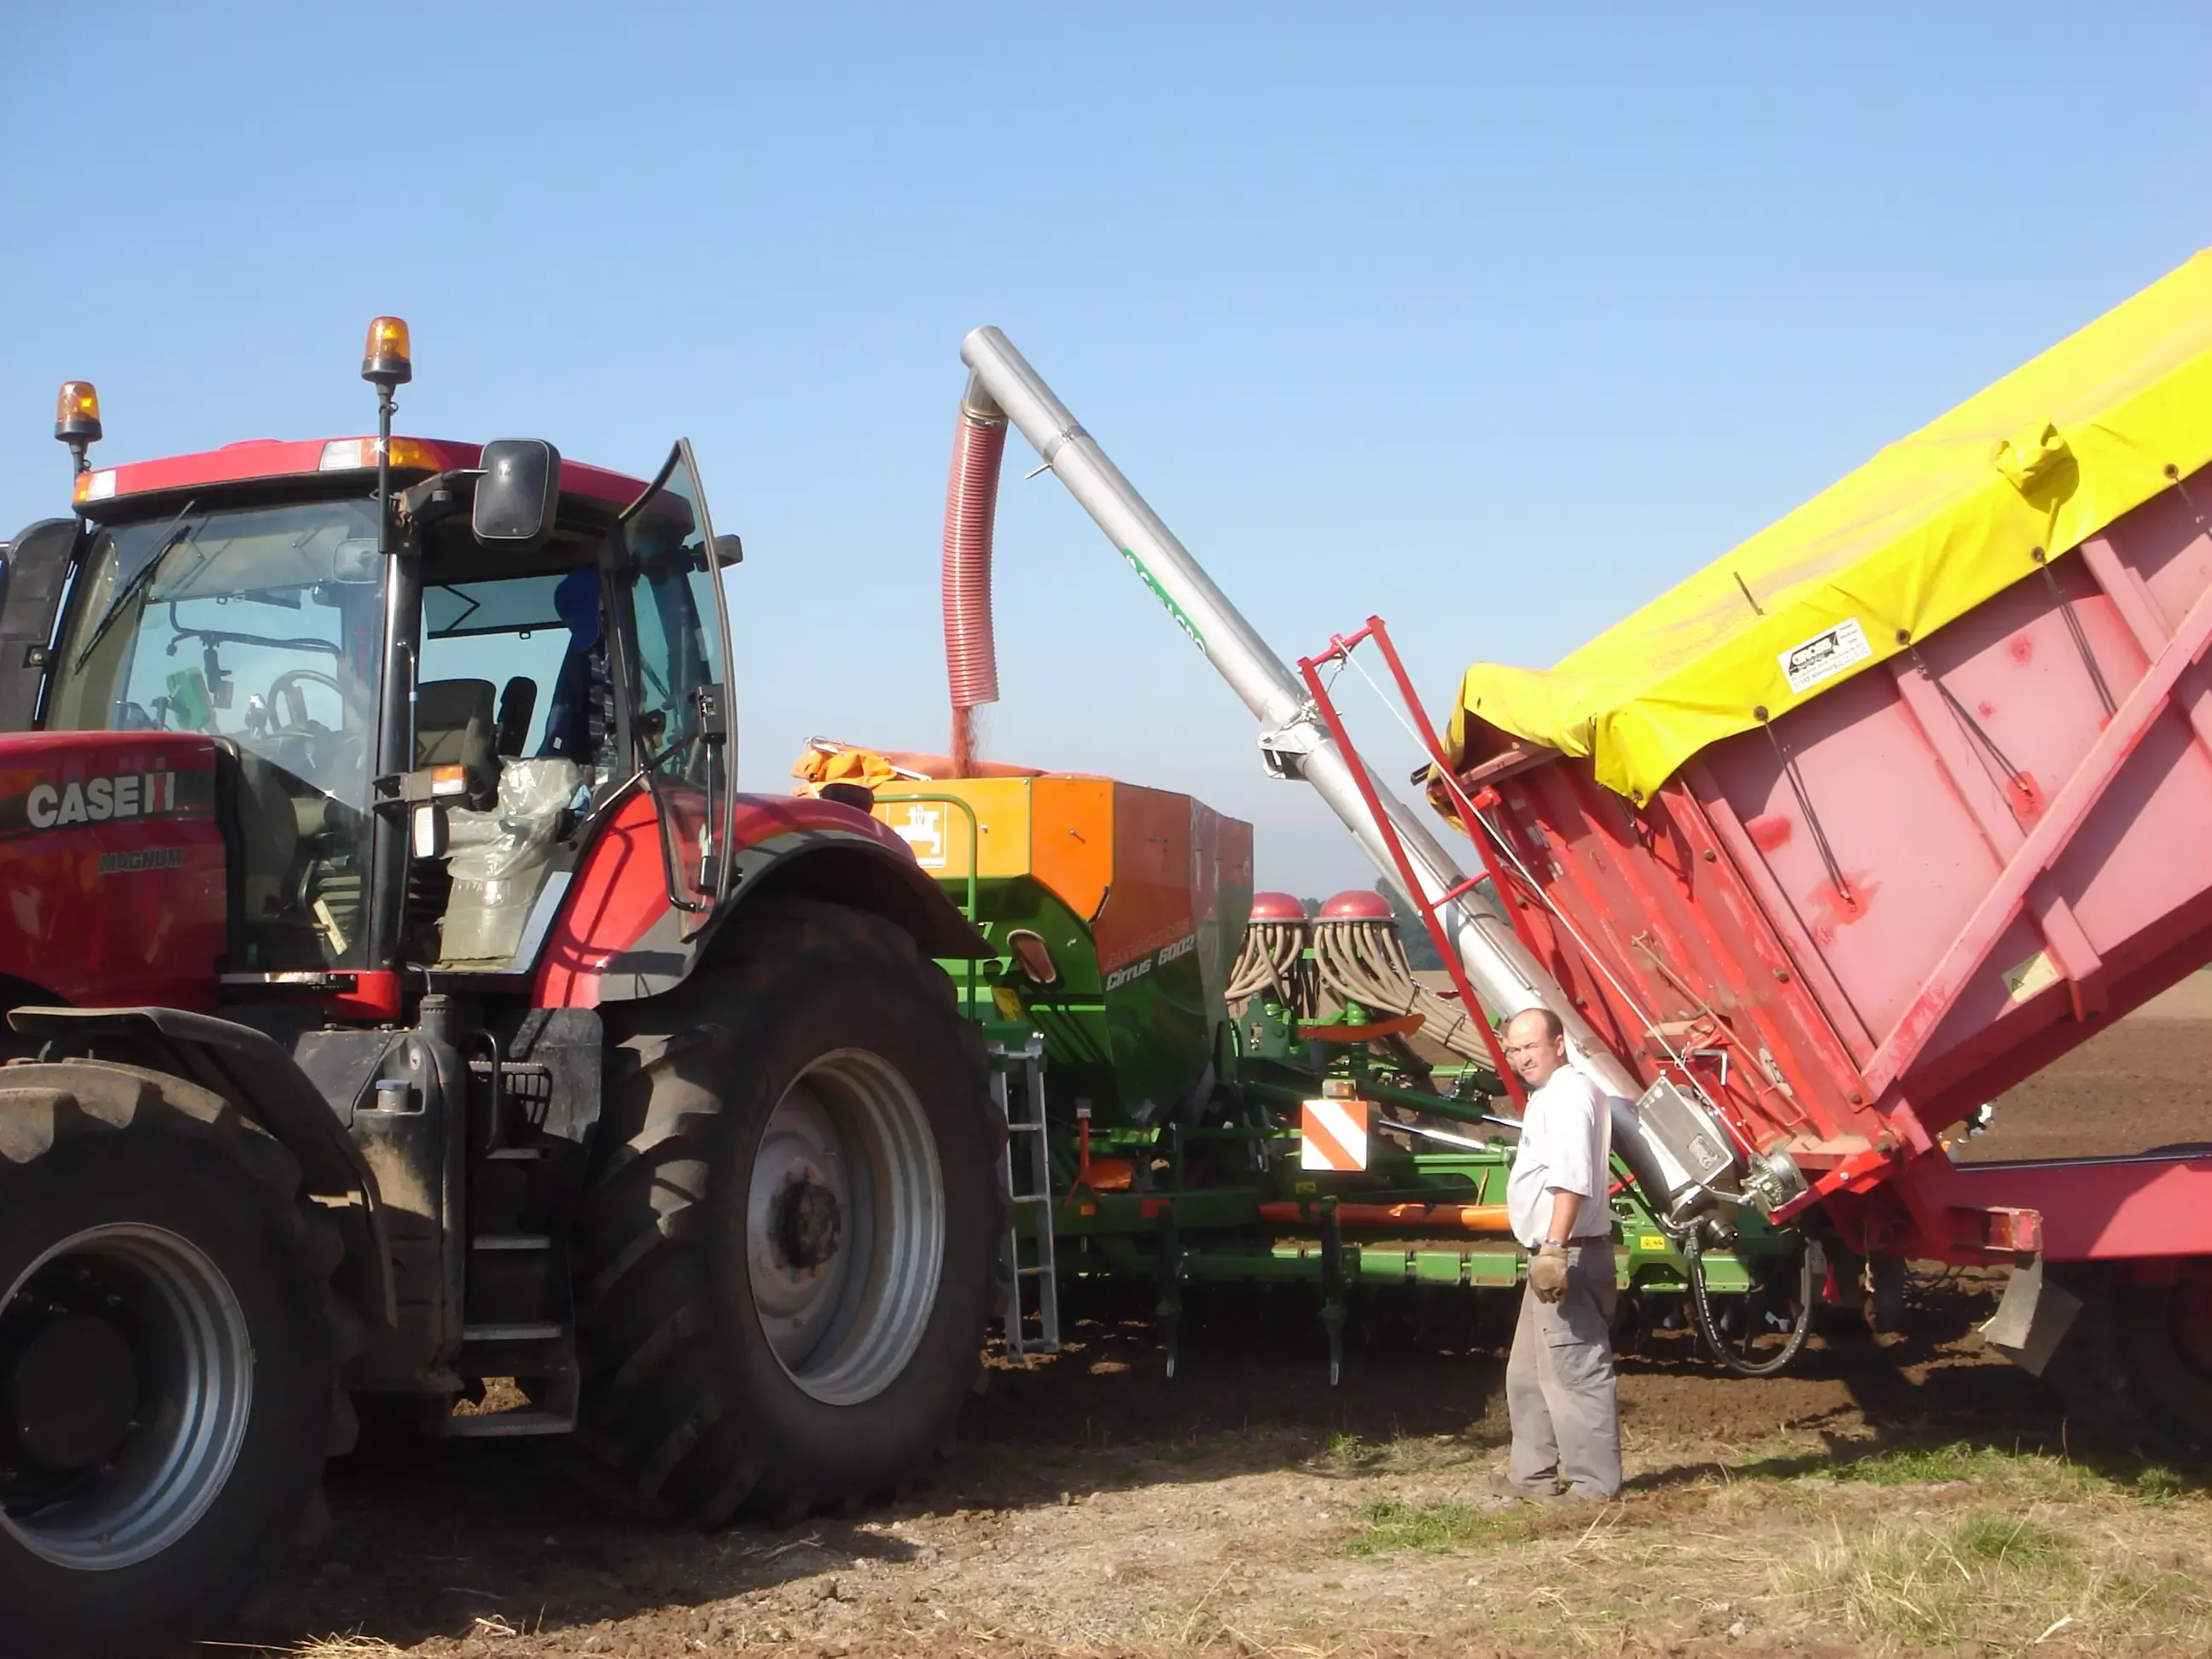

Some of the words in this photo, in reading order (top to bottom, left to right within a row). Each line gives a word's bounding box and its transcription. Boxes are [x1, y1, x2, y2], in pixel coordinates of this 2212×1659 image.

[27, 776, 139, 829] CASE
[99, 847, 183, 874] MAGNUM
[1106, 958, 1153, 992] Cirrus
[1157, 934, 1195, 967] 6002
